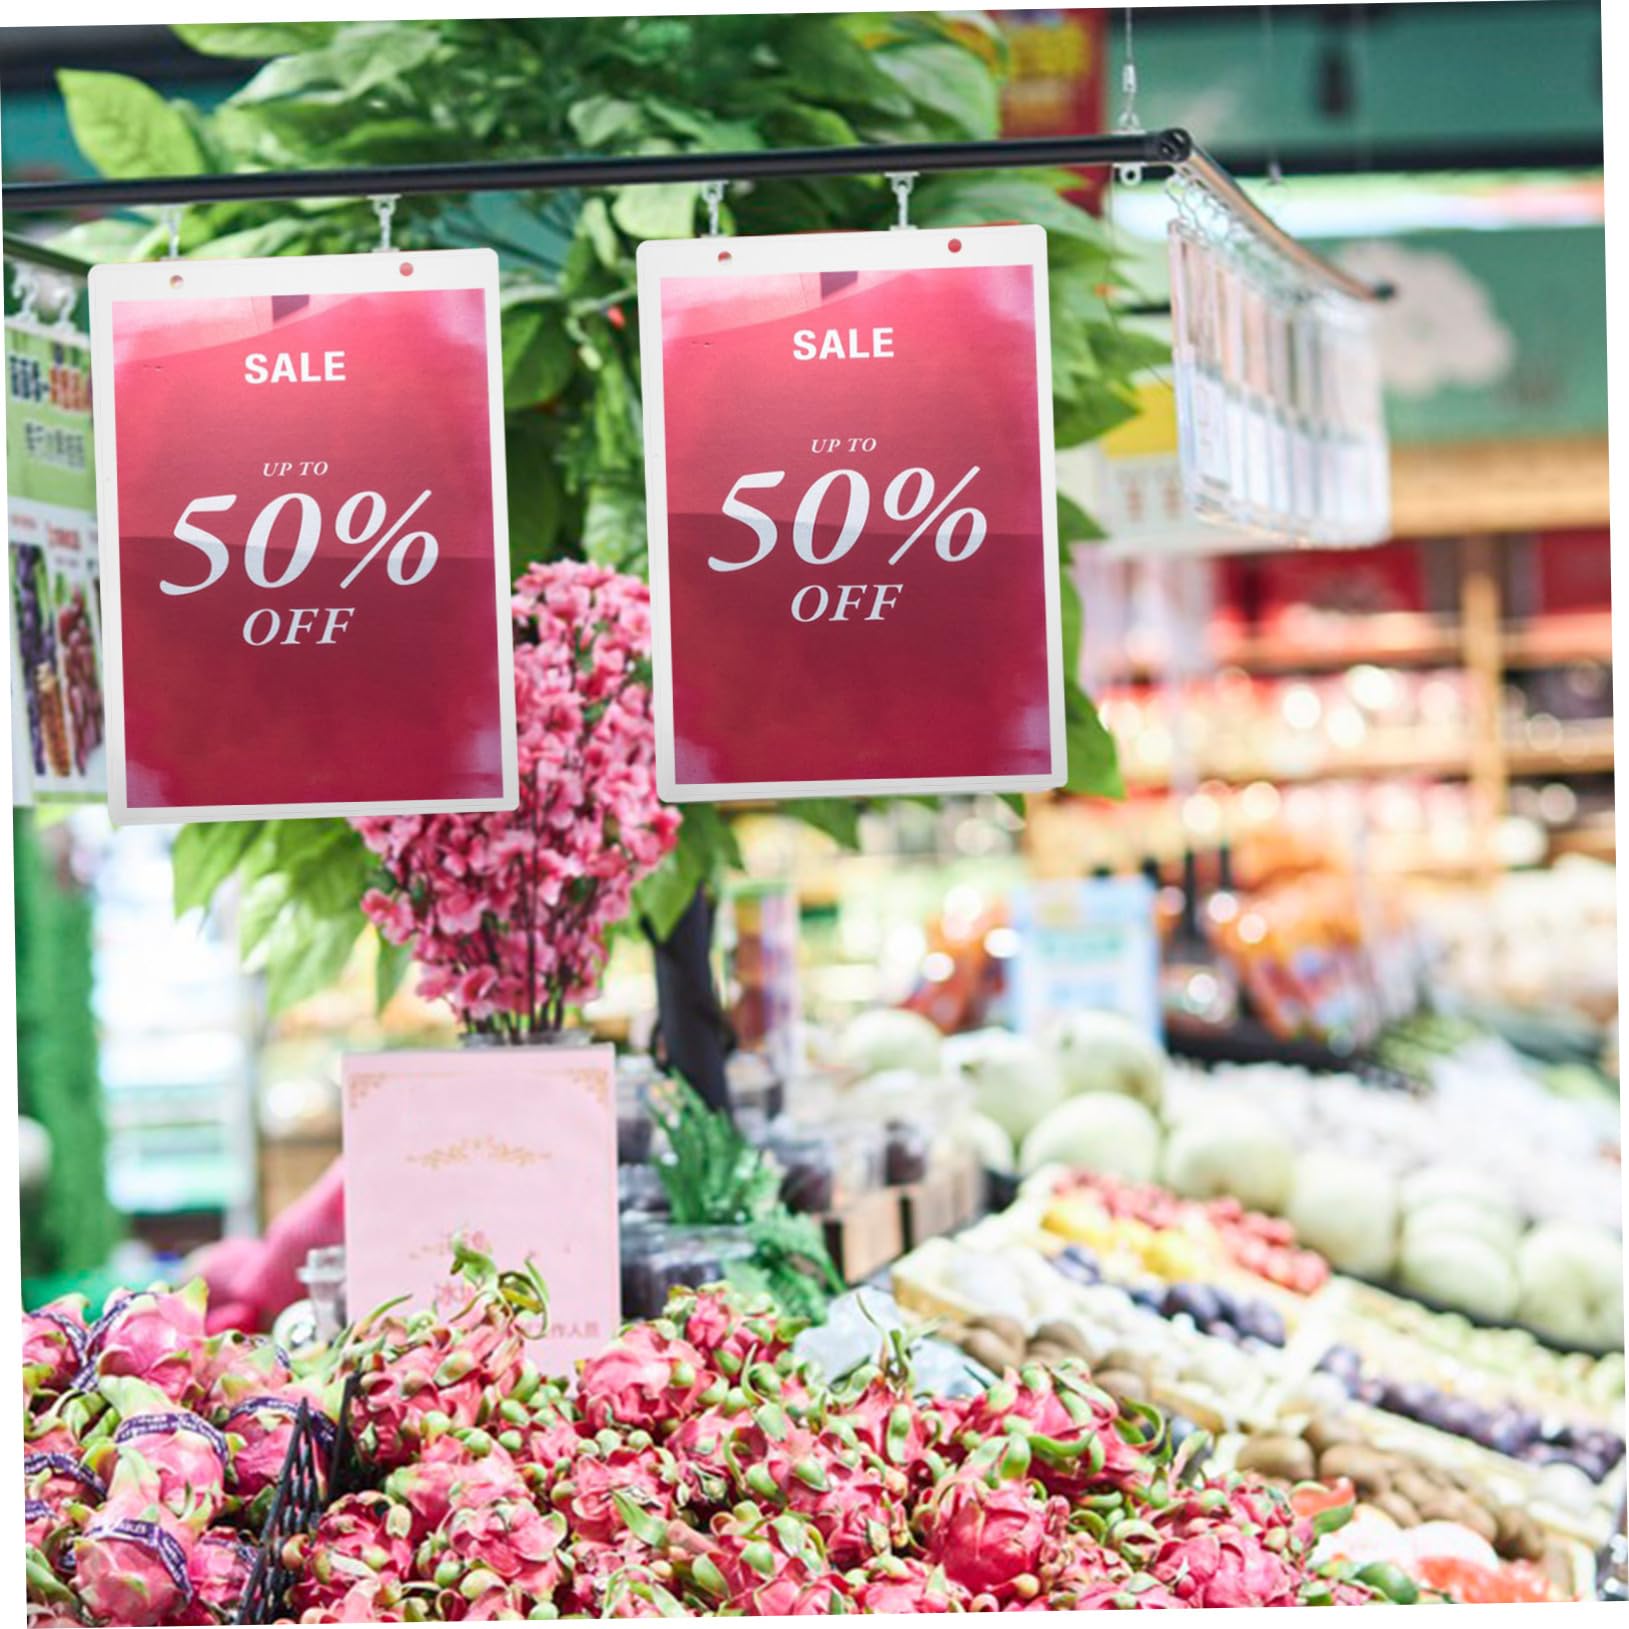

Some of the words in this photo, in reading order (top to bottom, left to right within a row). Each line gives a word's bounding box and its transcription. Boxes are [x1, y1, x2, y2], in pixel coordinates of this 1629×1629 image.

[793, 328, 894, 361] SALE
[245, 351, 346, 385] SALE
[811, 438, 840, 454] UP
[848, 438, 876, 454] TO
[263, 462, 292, 478] UP
[299, 461, 329, 477] TO
[708, 466, 987, 573] 50%
[160, 490, 438, 596] 50%
[791, 584, 903, 622] OFF
[243, 608, 355, 646] OFF
